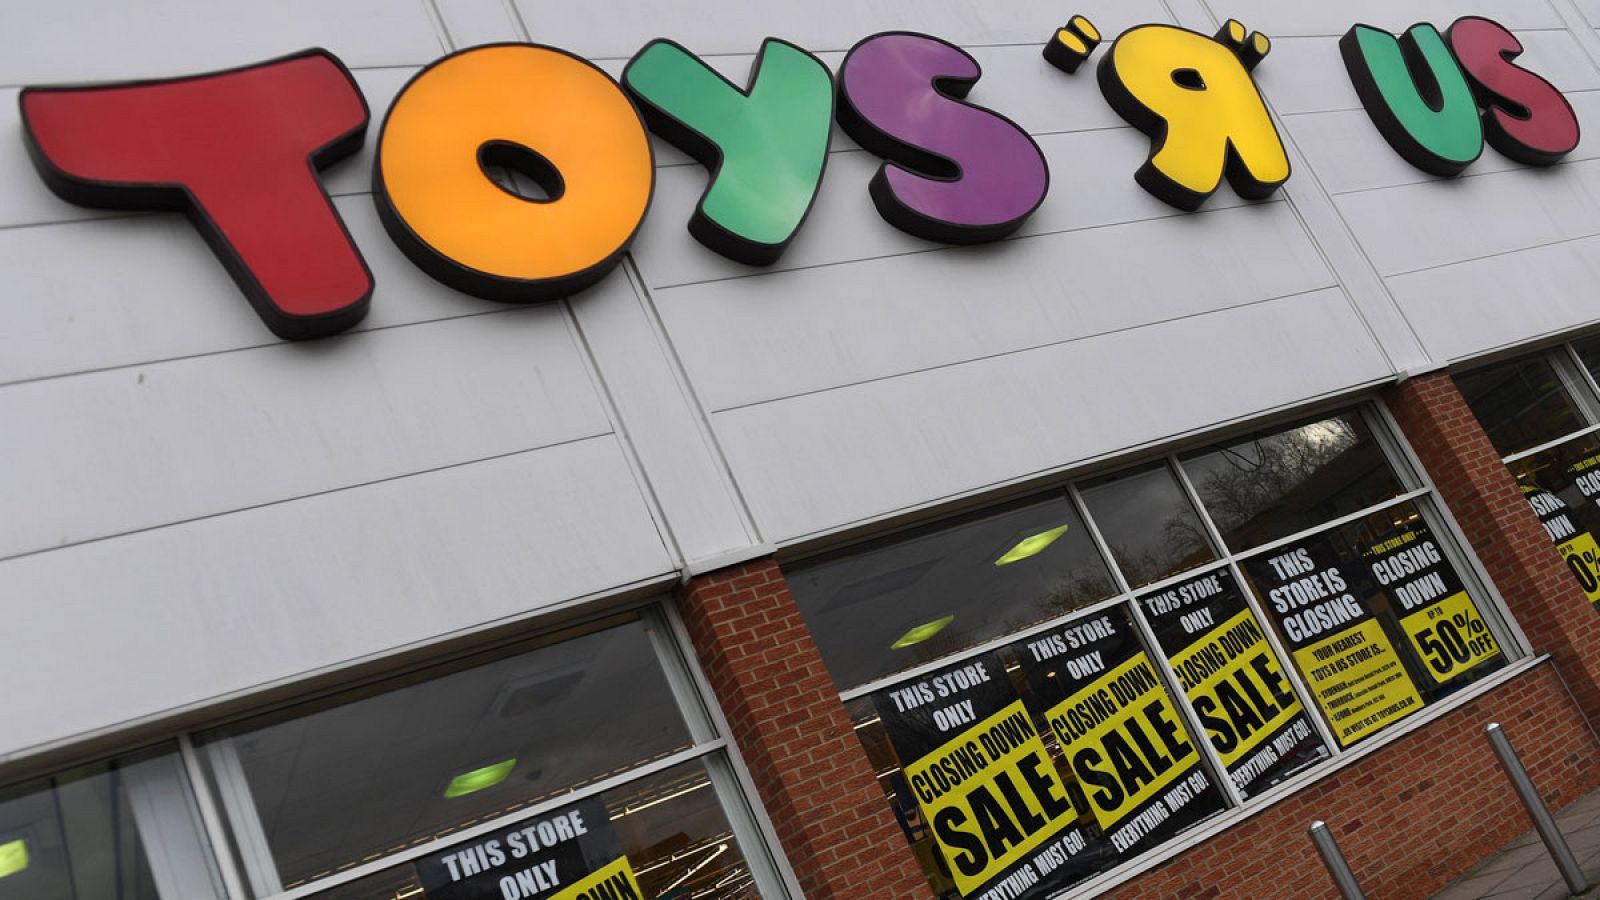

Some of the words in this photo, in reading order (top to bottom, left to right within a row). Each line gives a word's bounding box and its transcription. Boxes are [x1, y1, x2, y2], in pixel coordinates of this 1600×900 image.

[20, 30, 1049, 341] TOYS
[1339, 15, 1581, 178] US
[1268, 547, 1315, 582] THIS
[1371, 540, 1442, 586] CLOSING
[1145, 590, 1181, 617] THIS
[1182, 575, 1223, 606] STORE
[1268, 575, 1329, 614] STORE
[1325, 567, 1347, 596] IS
[1395, 571, 1448, 611] DOWN
[1028, 638, 1067, 664] THIS
[1068, 615, 1116, 651] STORE
[1179, 607, 1215, 635] ONLY
[1217, 617, 1262, 661] DOWN
[1283, 594, 1364, 643] CLOSING
[1414, 609, 1484, 674] 50%
[1066, 650, 1106, 681] ONLY
[1311, 665, 1333, 682] TOYS
[1346, 648, 1373, 667] STORE
[1312, 645, 1335, 662] YOUR
[1331, 631, 1366, 654] NEAREST
[1468, 634, 1493, 657] OFF
[889, 680, 936, 713] THIS
[937, 662, 991, 696] STORE
[1051, 694, 1117, 746] CLOSING
[1112, 661, 1158, 707] DOWN
[1191, 652, 1297, 756] SALE
[932, 699, 977, 732] ONLY
[1272, 727, 1298, 757] MUST
[1292, 718, 1311, 741] GO!
[911, 739, 986, 805] CLOSING
[979, 711, 1035, 763] DOWN
[1072, 699, 1193, 813] SALE
[933, 750, 1075, 877] SALE
[1110, 800, 1170, 853] EVERYTHING
[1163, 780, 1194, 813] MUST
[1187, 769, 1210, 794] GO!
[441, 839, 508, 882] THIS
[506, 809, 588, 859] STORE
[1033, 841, 1069, 877] MUST
[1062, 828, 1087, 856] GO!
[499, 859, 560, 900] ONLY
